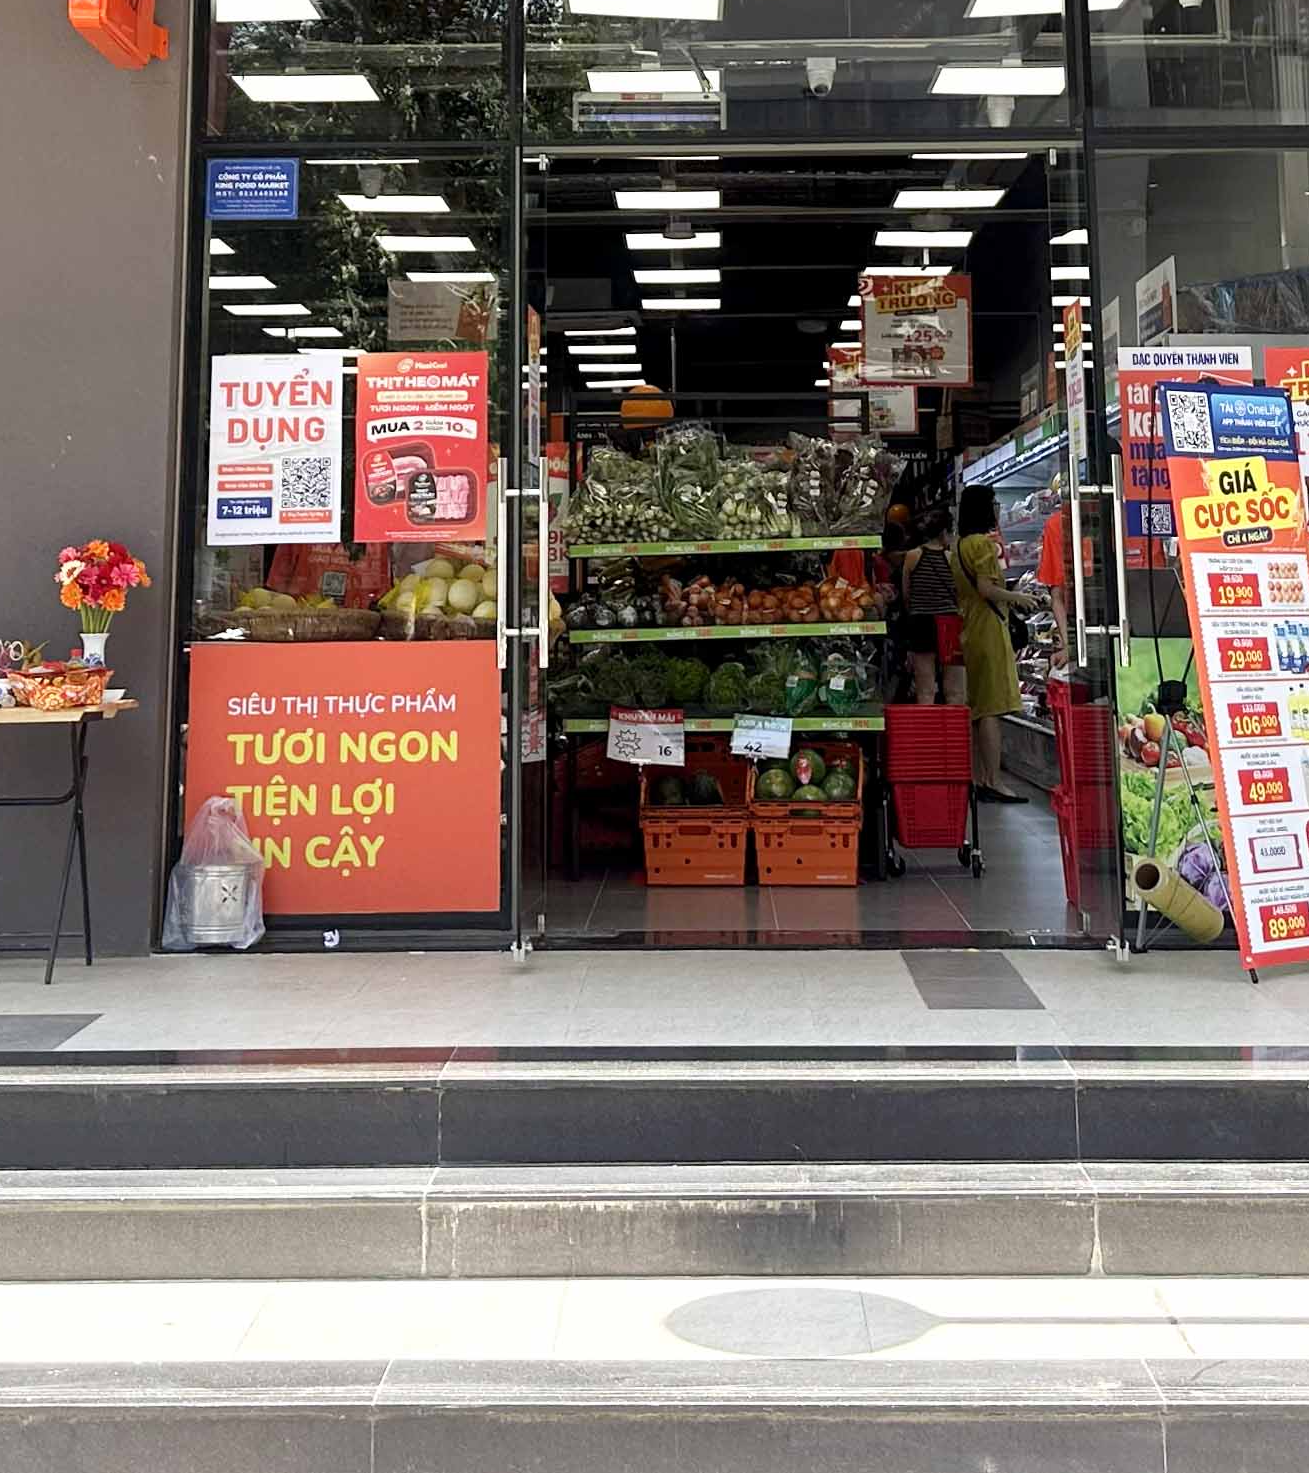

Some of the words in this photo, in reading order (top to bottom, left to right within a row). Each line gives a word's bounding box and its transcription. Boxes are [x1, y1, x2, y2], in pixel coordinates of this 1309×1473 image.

[219, 368, 333, 408] TUYỂN
[226, 416, 326, 451] DỤNG
[371, 421, 410, 436] MUA
[413, 420, 424, 431] 2
[1219, 462, 1257, 496] GIÁ
[1194, 500, 1241, 534] CỰC
[1246, 487, 1290, 524] SỐC
[1218, 585, 1253, 605] 19.900
[1227, 649, 1263, 669] 29.000
[227, 692, 276, 716] SIÊU
[282, 695, 319, 718] THỊ
[324, 693, 385, 717] THỰC
[392, 688, 456, 713] PHẨM
[1234, 715, 1278, 736] 106.000
[227, 728, 326, 766] TƯƠI
[339, 730, 459, 763] NGON
[658, 744, 673, 757] 16
[226, 774, 317, 826] TIỆN
[331, 778, 396, 825] LỢI
[1249, 781, 1284, 803] 49.000
[247, 836, 292, 869] IN
[305, 826, 385, 877] CẬY
[1269, 915, 1306, 939] 89.000
